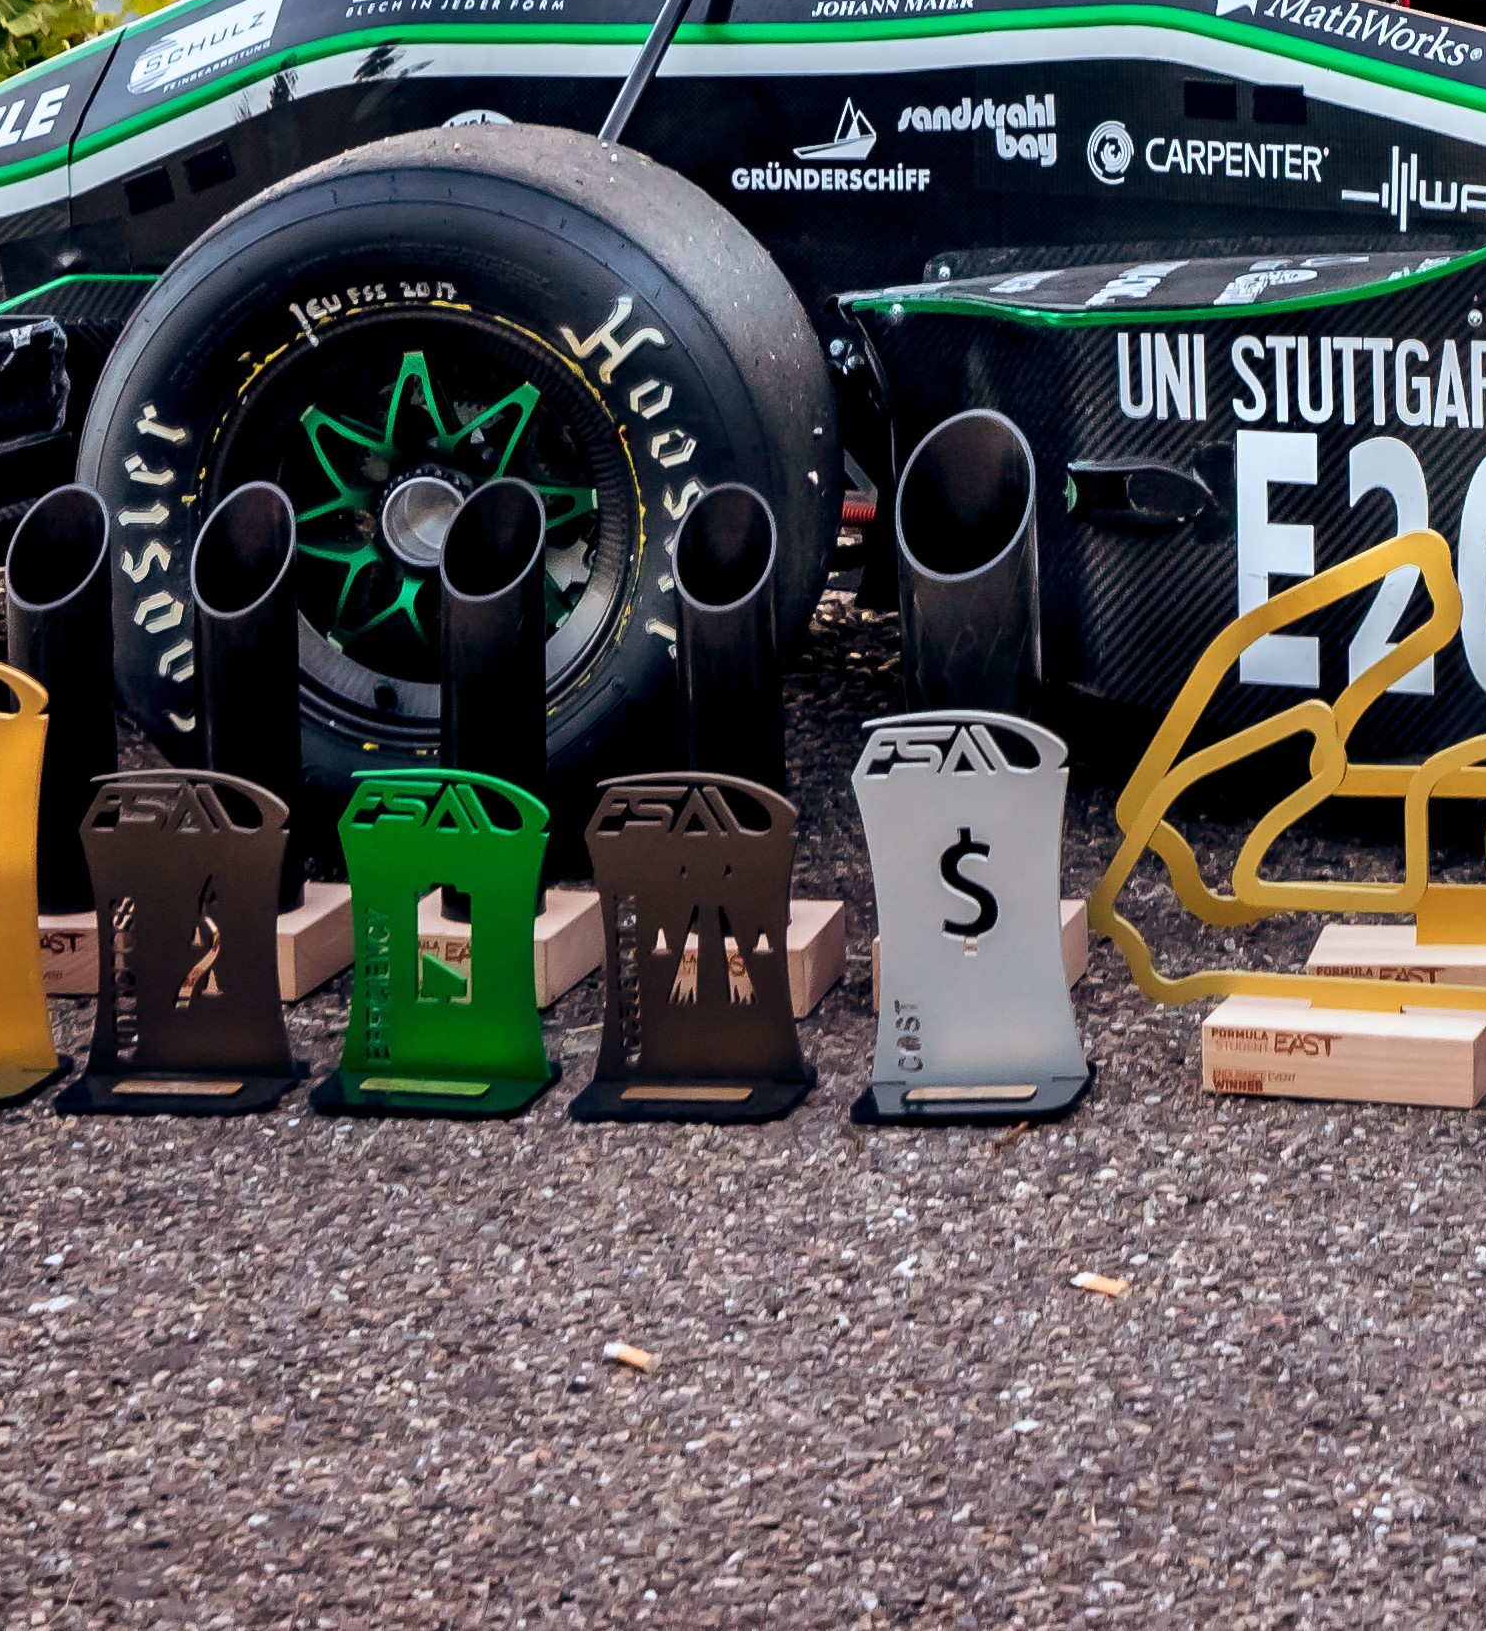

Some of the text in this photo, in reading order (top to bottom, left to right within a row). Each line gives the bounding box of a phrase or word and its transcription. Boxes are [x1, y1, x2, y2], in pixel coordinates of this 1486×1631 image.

[345, 0, 402, 18] BLECH
[411, 0, 432, 10] IN
[510, 0, 565, 11] FORM
[144, 10, 266, 74] SCHULZ
[898, 93, 1056, 132] sandstrahl
[996, 126, 1057, 167] bay
[1145, 137, 1327, 183] CARPENTER
[399, 280, 458, 301] 2017
[1118, 331, 1207, 422] UNI
[1316, 965, 1374, 978] FORMULA
[894, 999, 924, 1072] COST
[1211, 1027, 1342, 1058] FORMULA EAST
